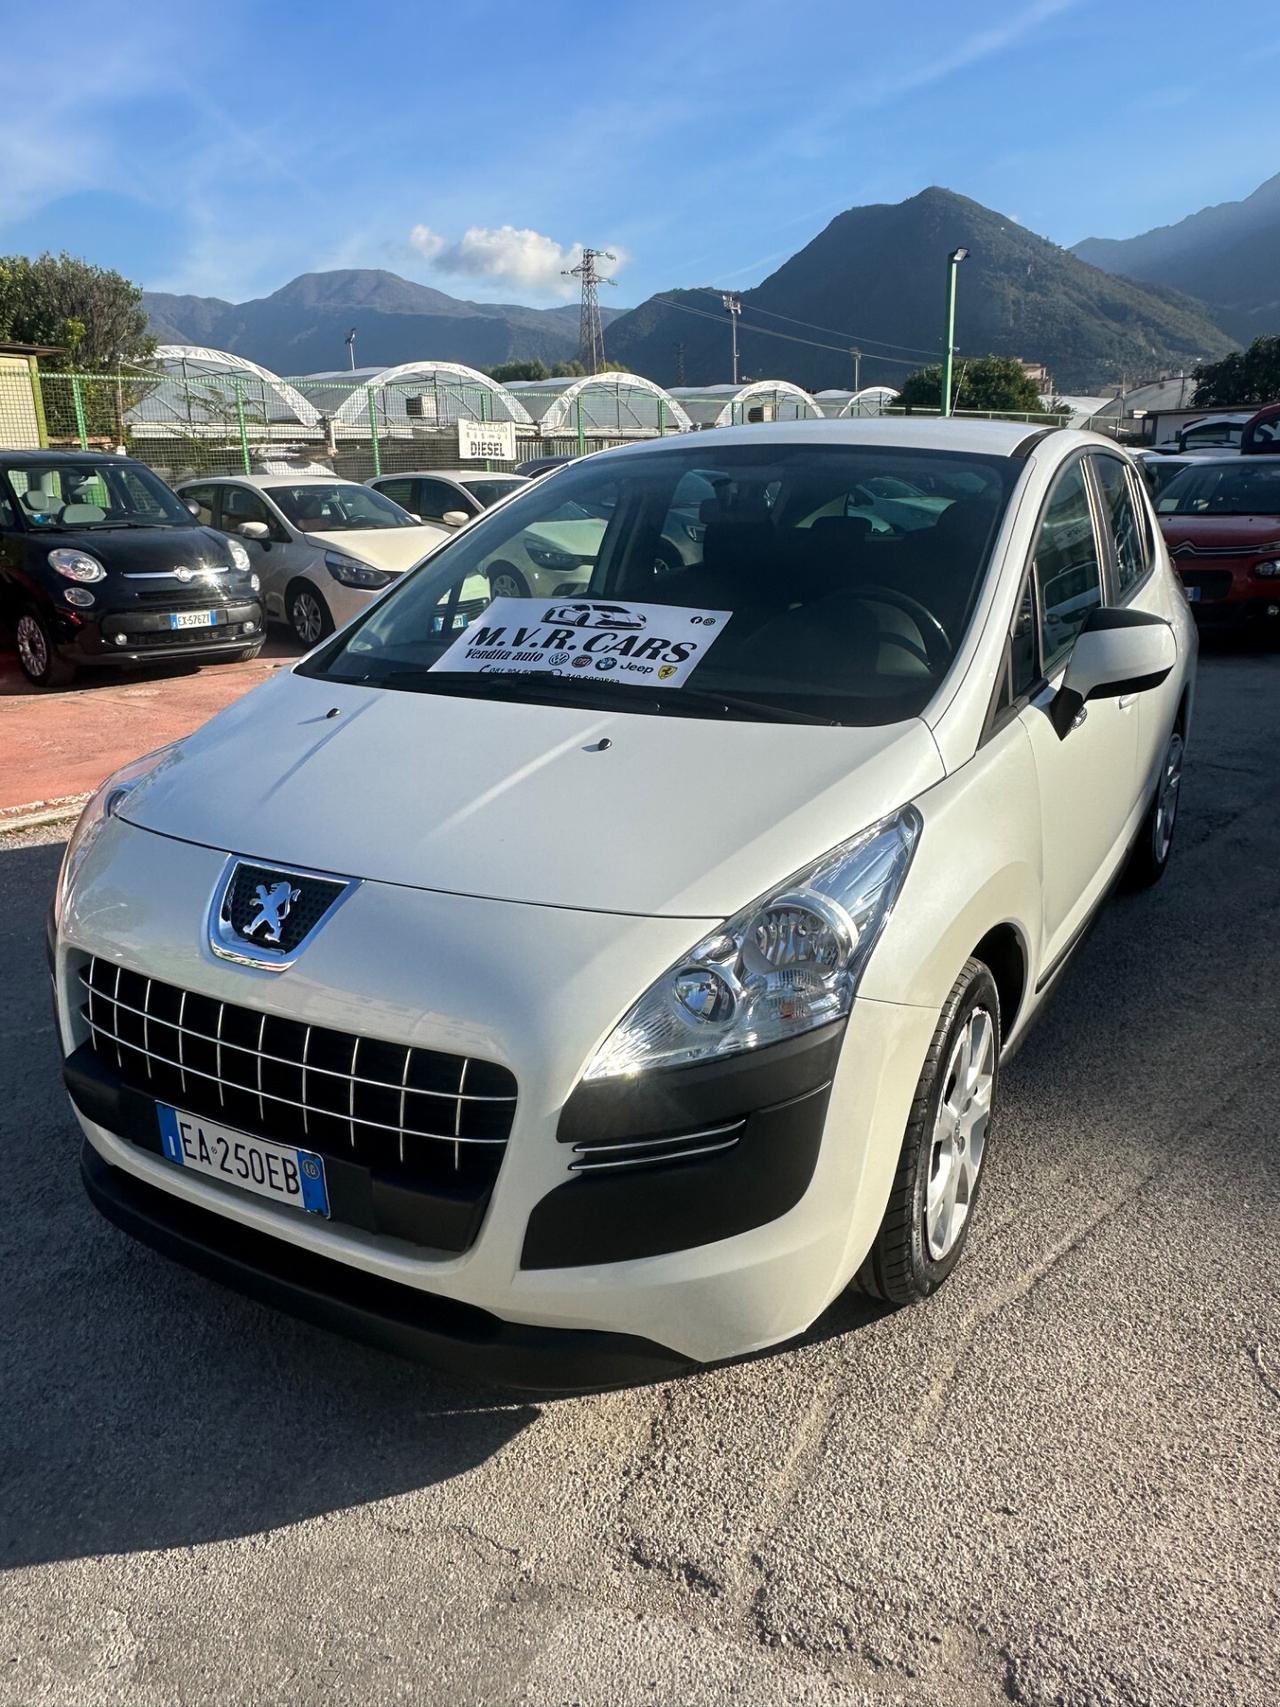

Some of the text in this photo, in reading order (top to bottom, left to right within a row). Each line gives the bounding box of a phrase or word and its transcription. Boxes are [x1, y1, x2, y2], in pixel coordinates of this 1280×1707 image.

[470, 440, 505, 456] DIESEL
[464, 648, 544, 662] Vendita auto
[620, 661, 654, 675] Jeep
